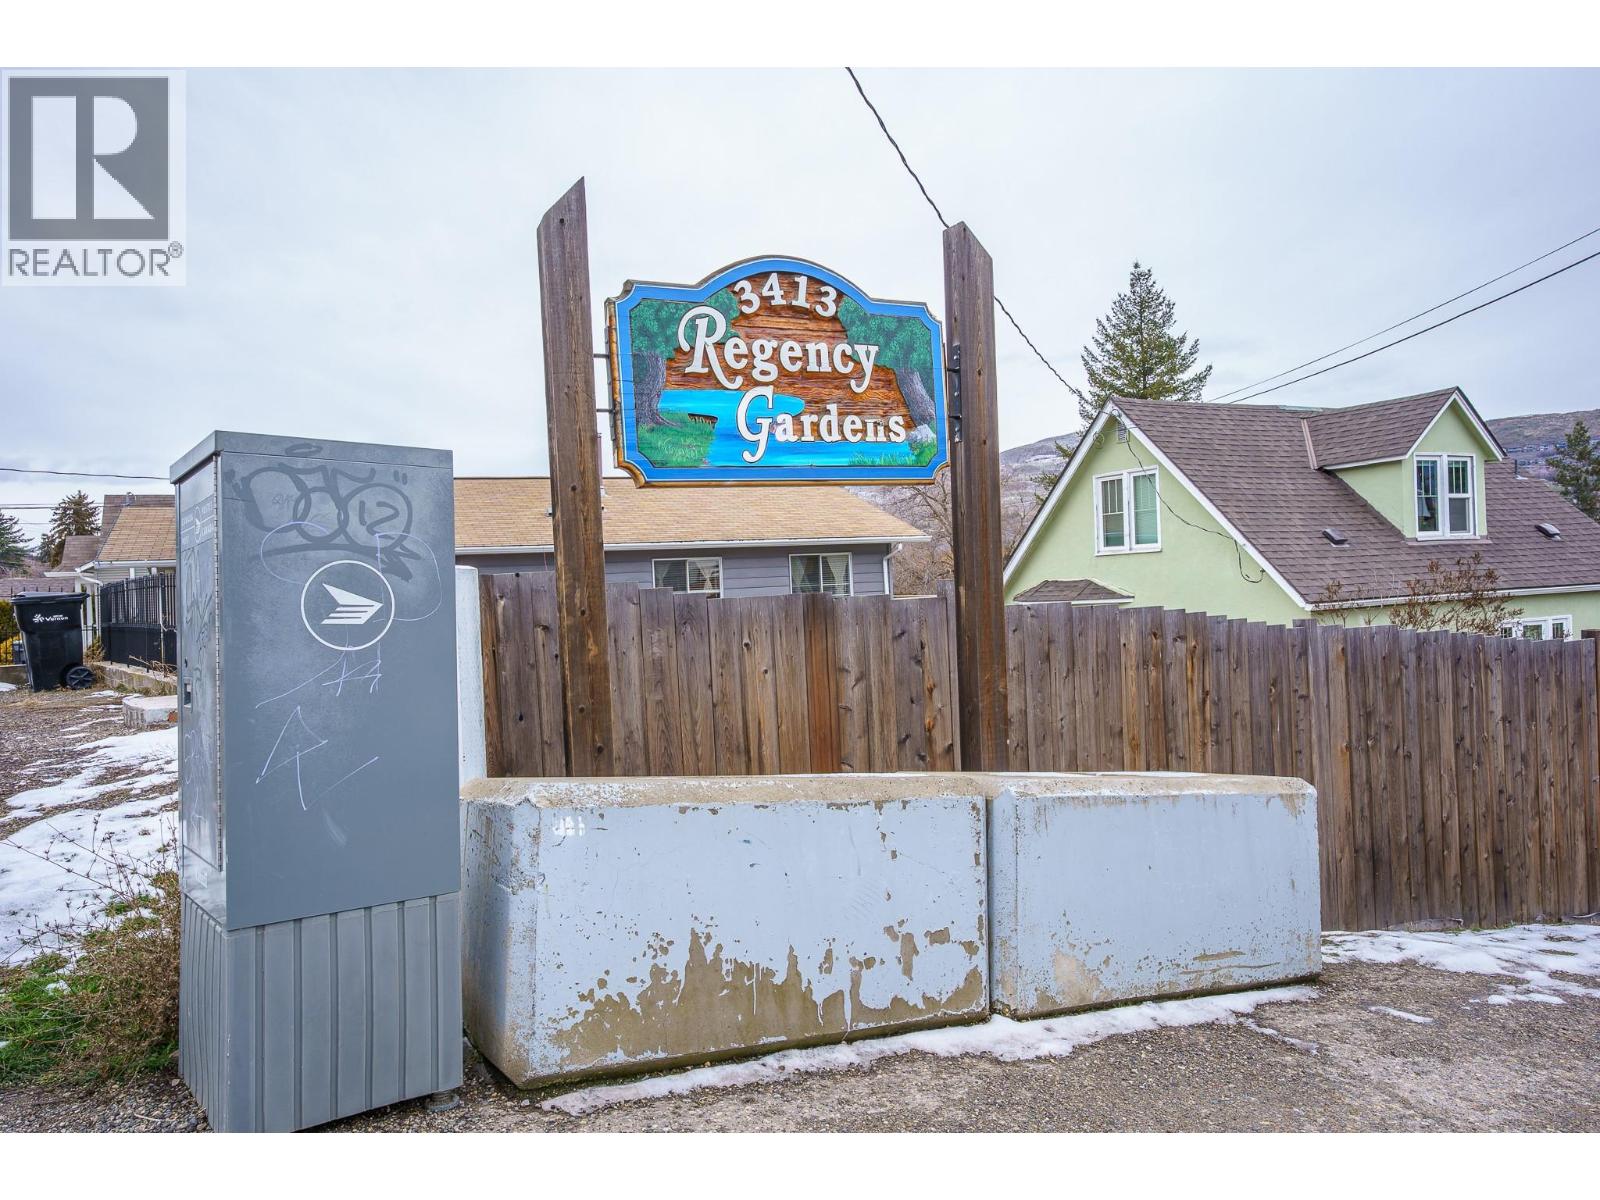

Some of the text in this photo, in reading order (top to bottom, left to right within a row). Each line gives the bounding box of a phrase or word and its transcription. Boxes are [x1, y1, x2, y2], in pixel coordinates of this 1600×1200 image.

[734, 272, 838, 318] 3413
[678, 306, 879, 394] Regency
[736, 385, 907, 464] Gardens
